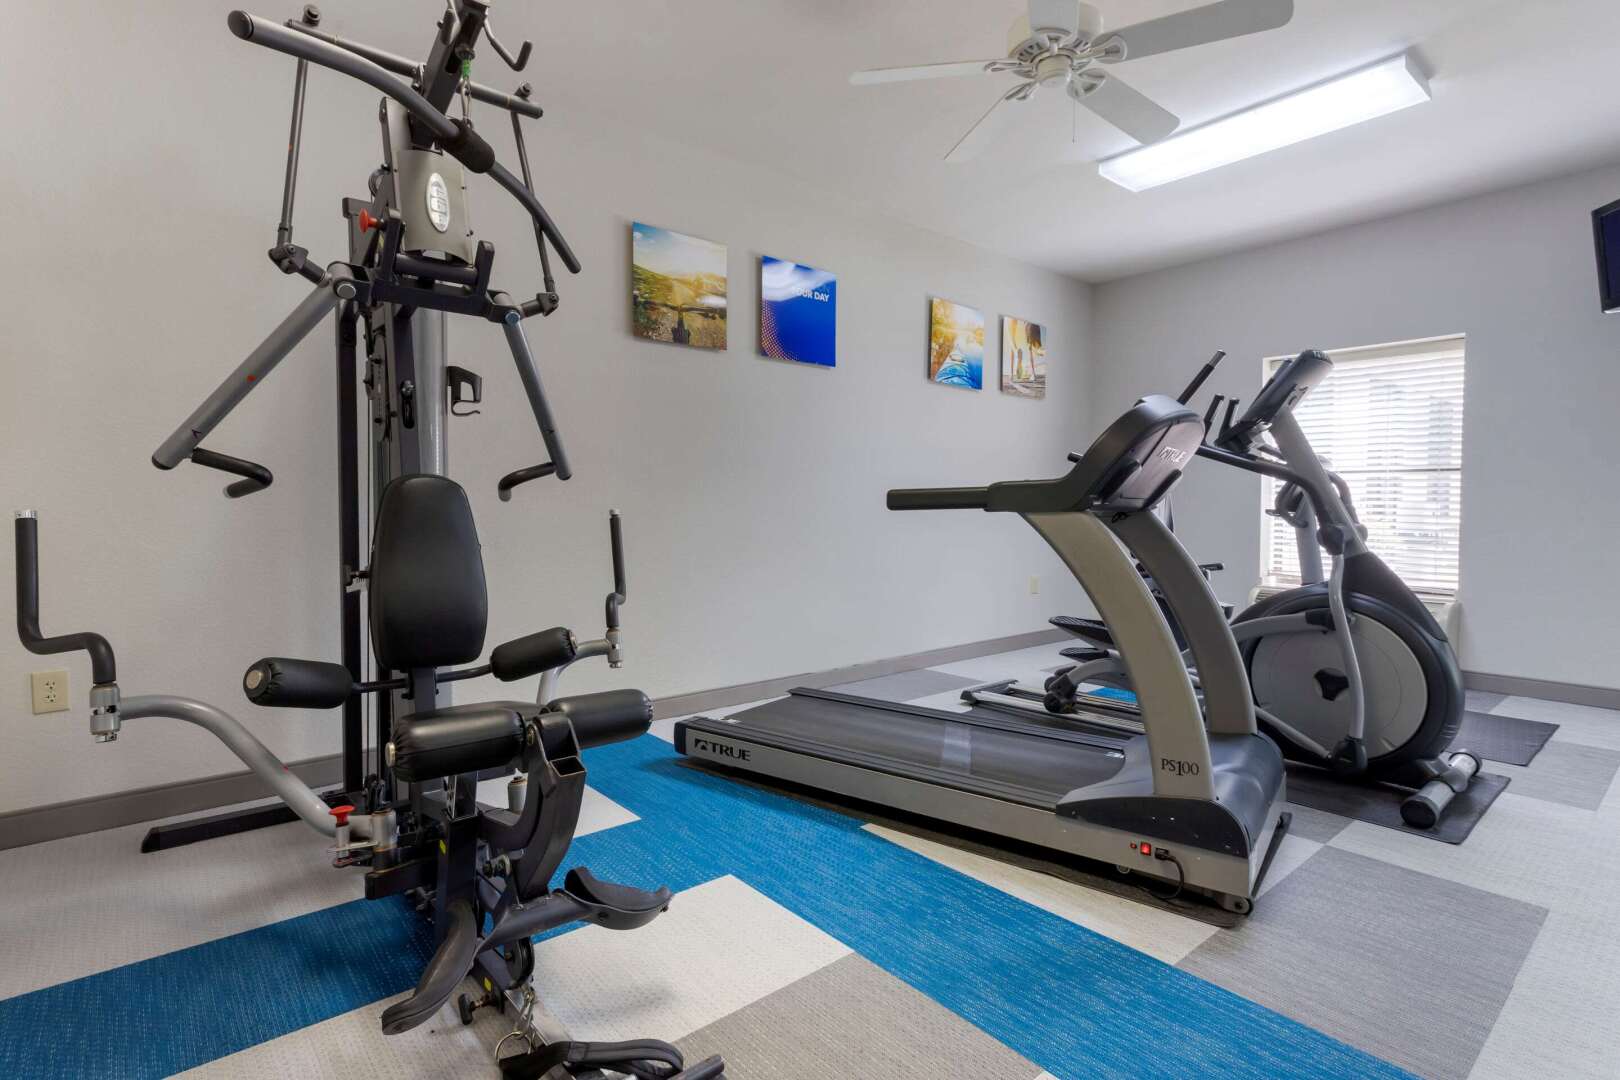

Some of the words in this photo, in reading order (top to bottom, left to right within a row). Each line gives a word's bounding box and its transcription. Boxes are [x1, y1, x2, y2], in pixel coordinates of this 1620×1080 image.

[814, 291, 830, 302] DAY
[709, 741, 752, 762] TRUE
[1161, 758, 1200, 776] PS100
